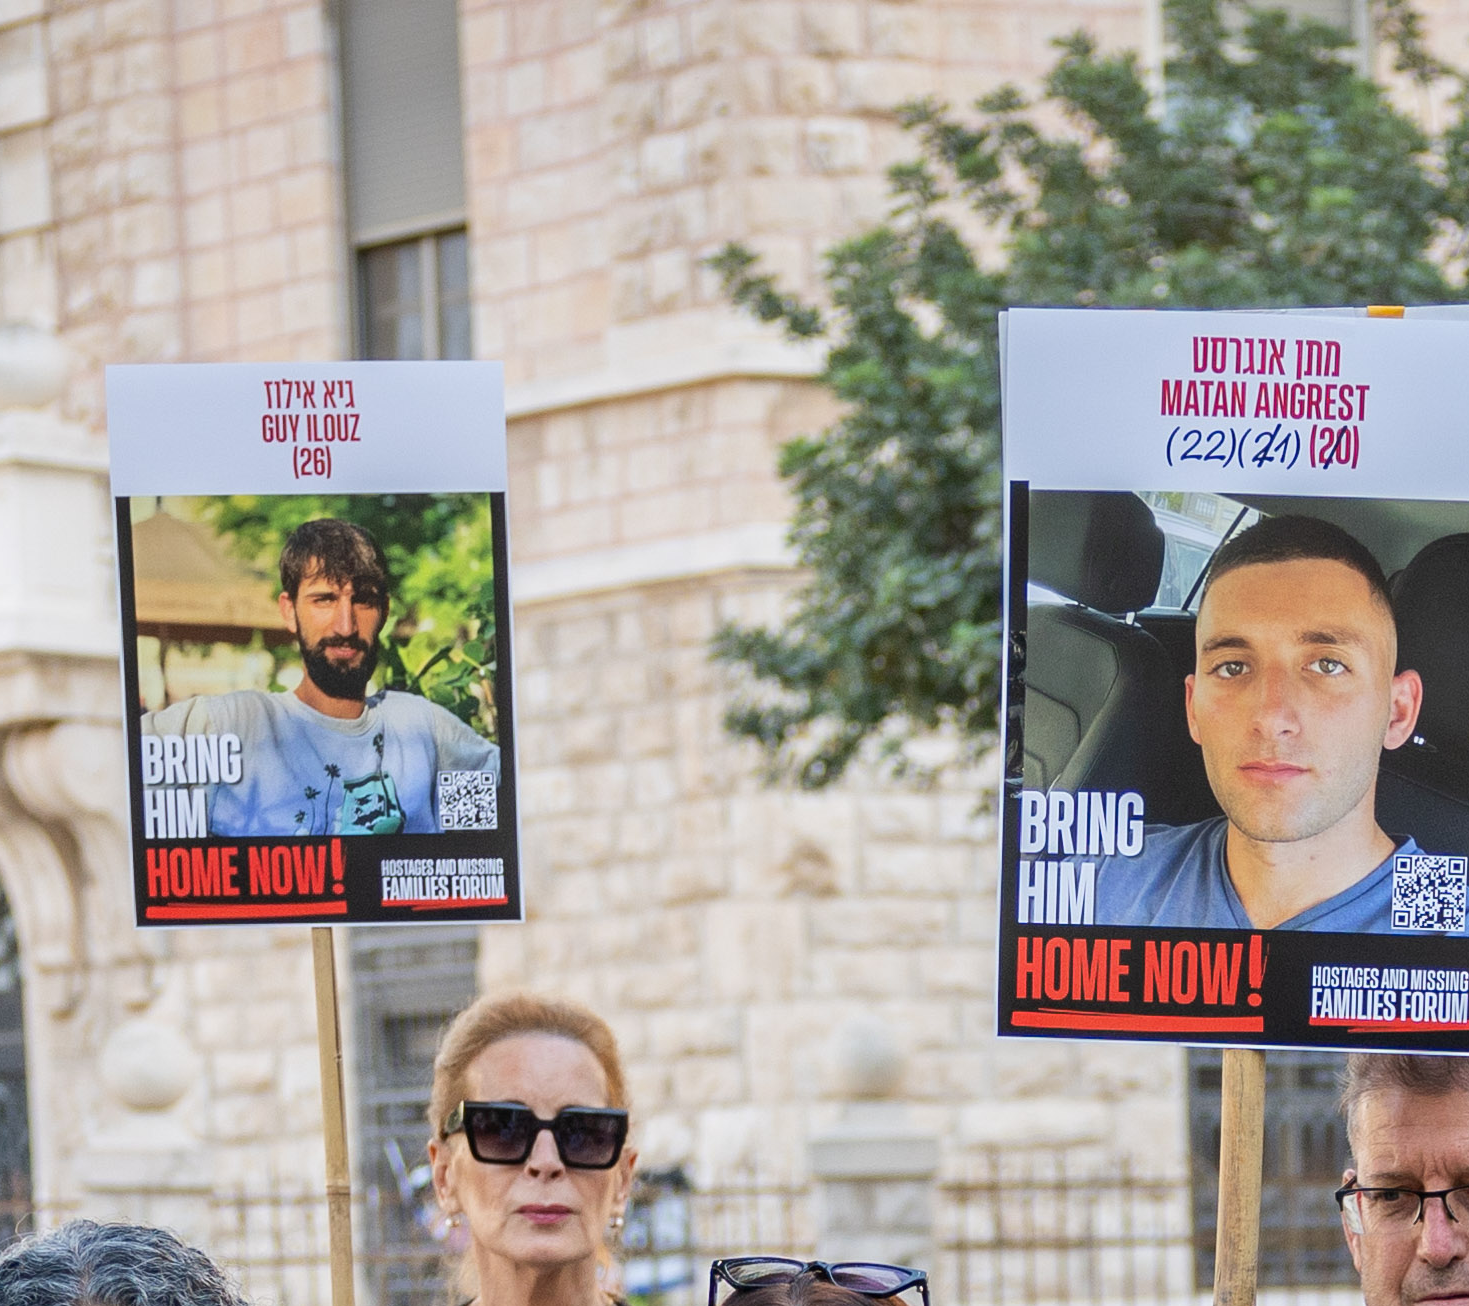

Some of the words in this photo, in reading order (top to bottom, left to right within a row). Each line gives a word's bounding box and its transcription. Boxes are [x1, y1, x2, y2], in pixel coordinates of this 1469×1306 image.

[1193, 336, 1286, 376] אנגרסט
[1295, 339, 1341, 381] מתן
[264, 378, 315, 409] אילוז
[323, 380, 355, 408] גיא
[1161, 380, 1246, 417] MATAN
[1254, 382, 1370, 421] ANGREST
[262, 414, 301, 442] GUY
[306, 414, 361, 442] ILOUZ
[1166, 426, 1237, 468] (22)
[293, 448, 332, 479] (26)
[142, 734, 243, 786] BRING
[144, 788, 207, 838] HIM
[1020, 790, 1143, 856] BRING
[145, 846, 238, 898] HOME
[249, 837, 347, 897] NOW!
[381, 860, 433, 876] HOSTAGES
[435, 859, 457, 876] AND
[458, 858, 504, 876] MISSING
[382, 876, 449, 900] FAMILIES
[452, 876, 505, 900] FORUM
[1019, 860, 1096, 925] HIM
[1017, 938, 1130, 1003] HOME
[1143, 935, 1266, 1007] NOW!
[1312, 966, 1379, 988] HOSTAGES
[1382, 968, 1409, 988] AND
[1410, 969, 1469, 993] MISSING
[1311, 988, 1396, 1021] FAMILIES
[1401, 992, 1469, 1024] FORUM
